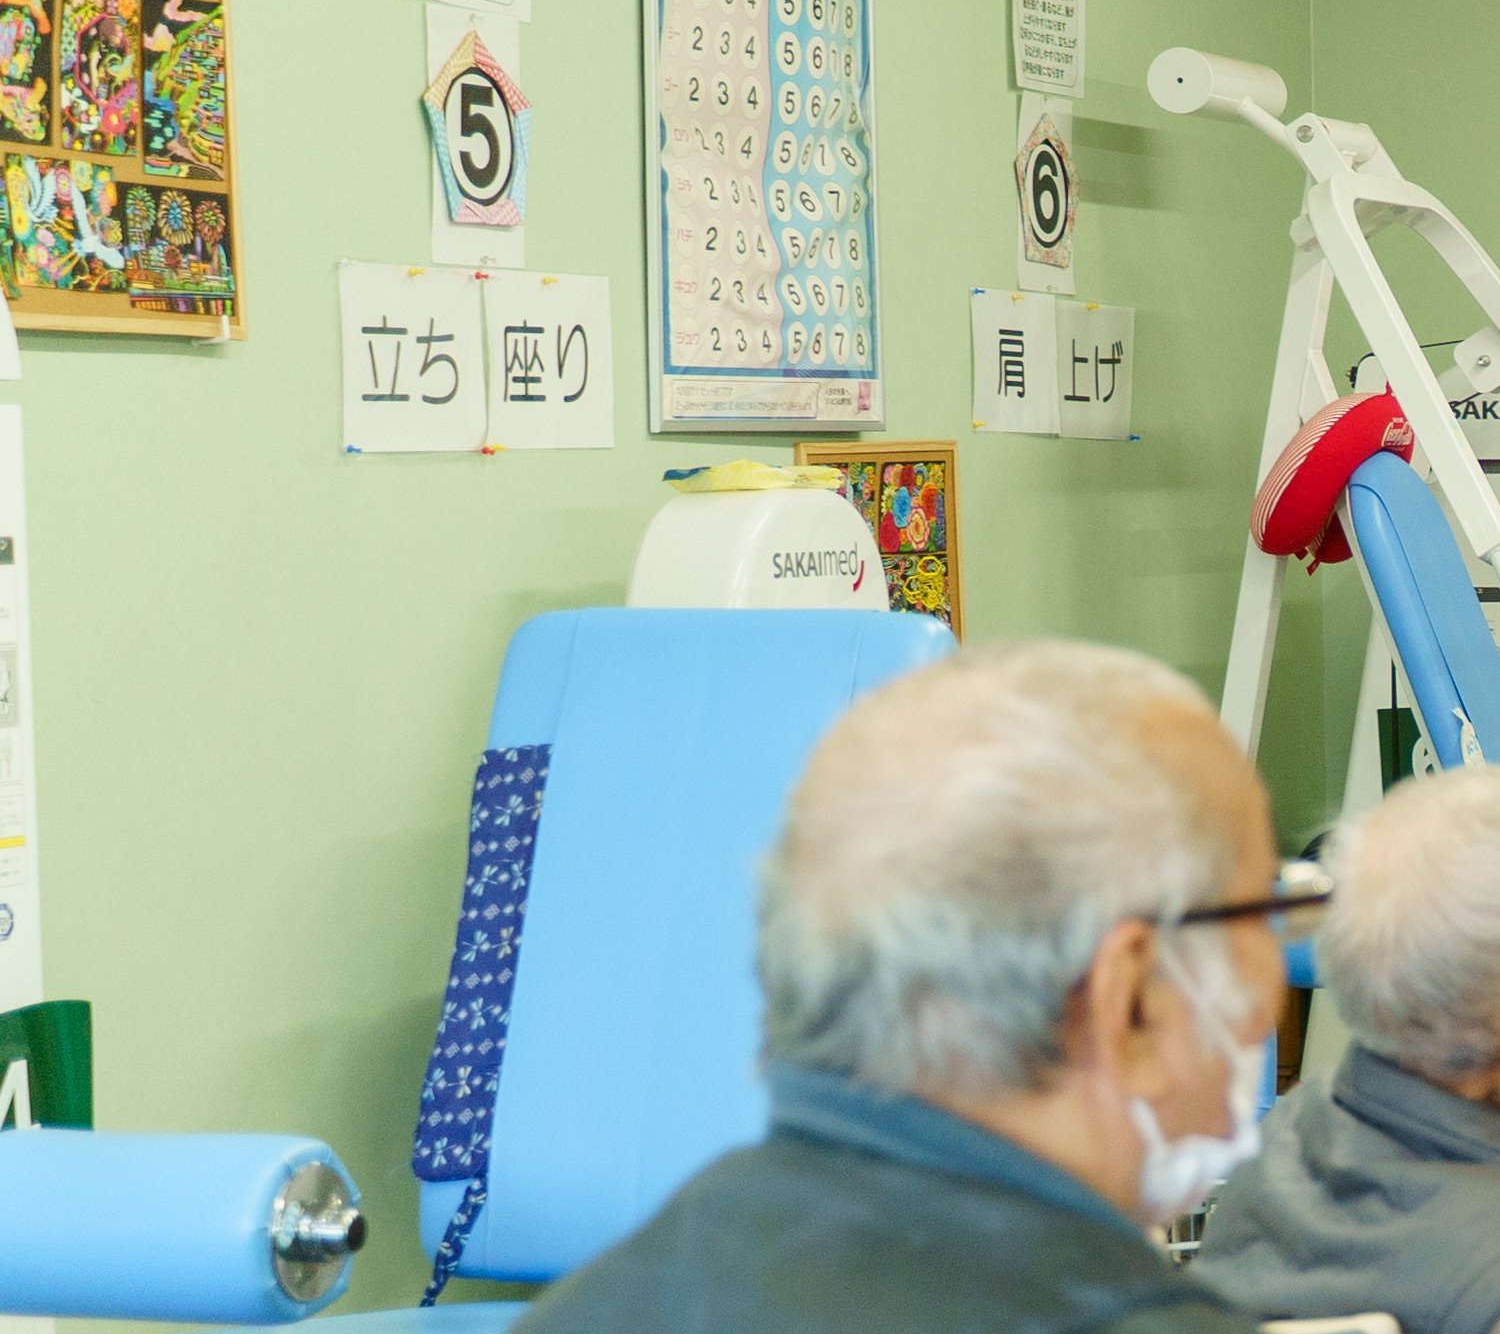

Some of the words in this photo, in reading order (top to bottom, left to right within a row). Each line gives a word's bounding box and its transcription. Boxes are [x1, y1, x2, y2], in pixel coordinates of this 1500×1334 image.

[459, 83, 504, 189] 5
[1031, 147, 1064, 237] 6
[773, 541, 858, 579] SAKAImed
